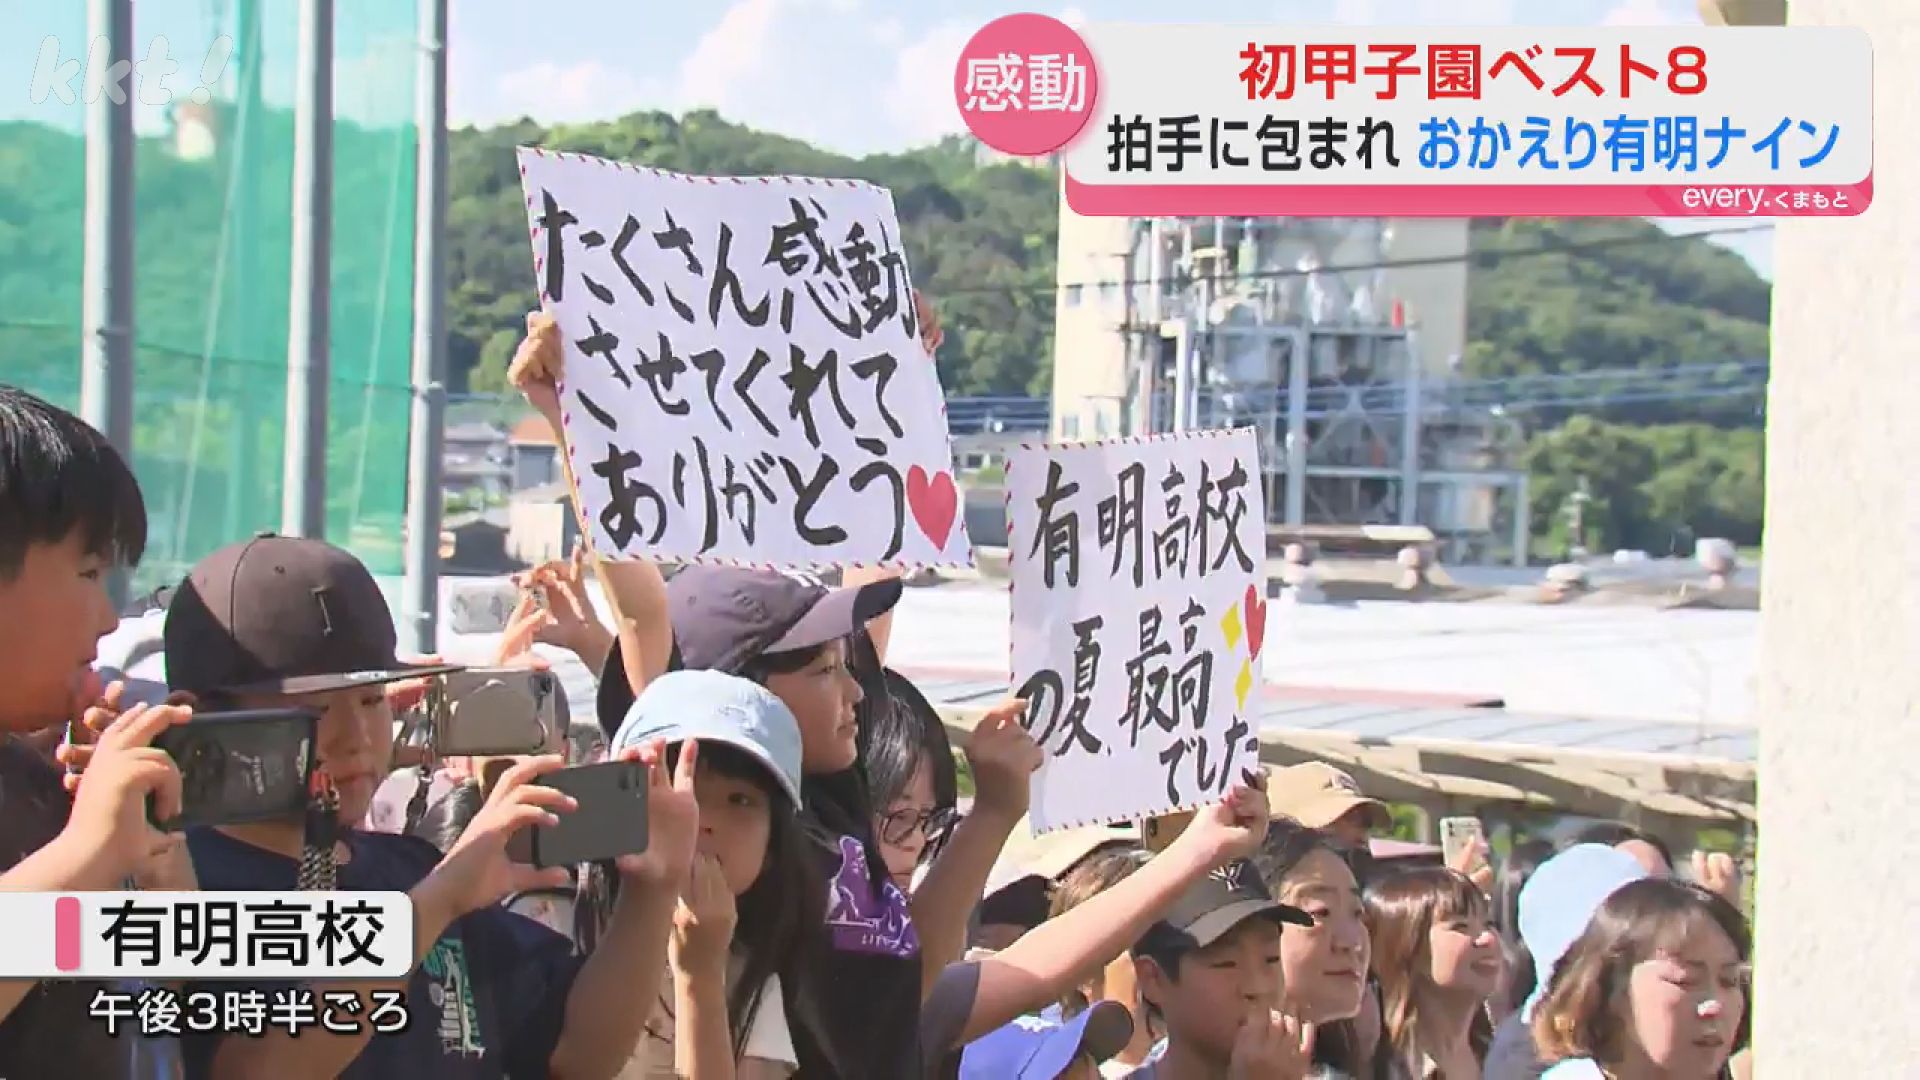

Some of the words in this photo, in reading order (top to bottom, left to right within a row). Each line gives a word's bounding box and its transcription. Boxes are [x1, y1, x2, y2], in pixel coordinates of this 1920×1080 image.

[535, 188, 916, 340] たくさん感動
[575, 314, 903, 449] させてくれて
[591, 436, 904, 561] ありがとう
[1028, 458, 1255, 589] 有明高校
[1159, 713, 1259, 806] でした
